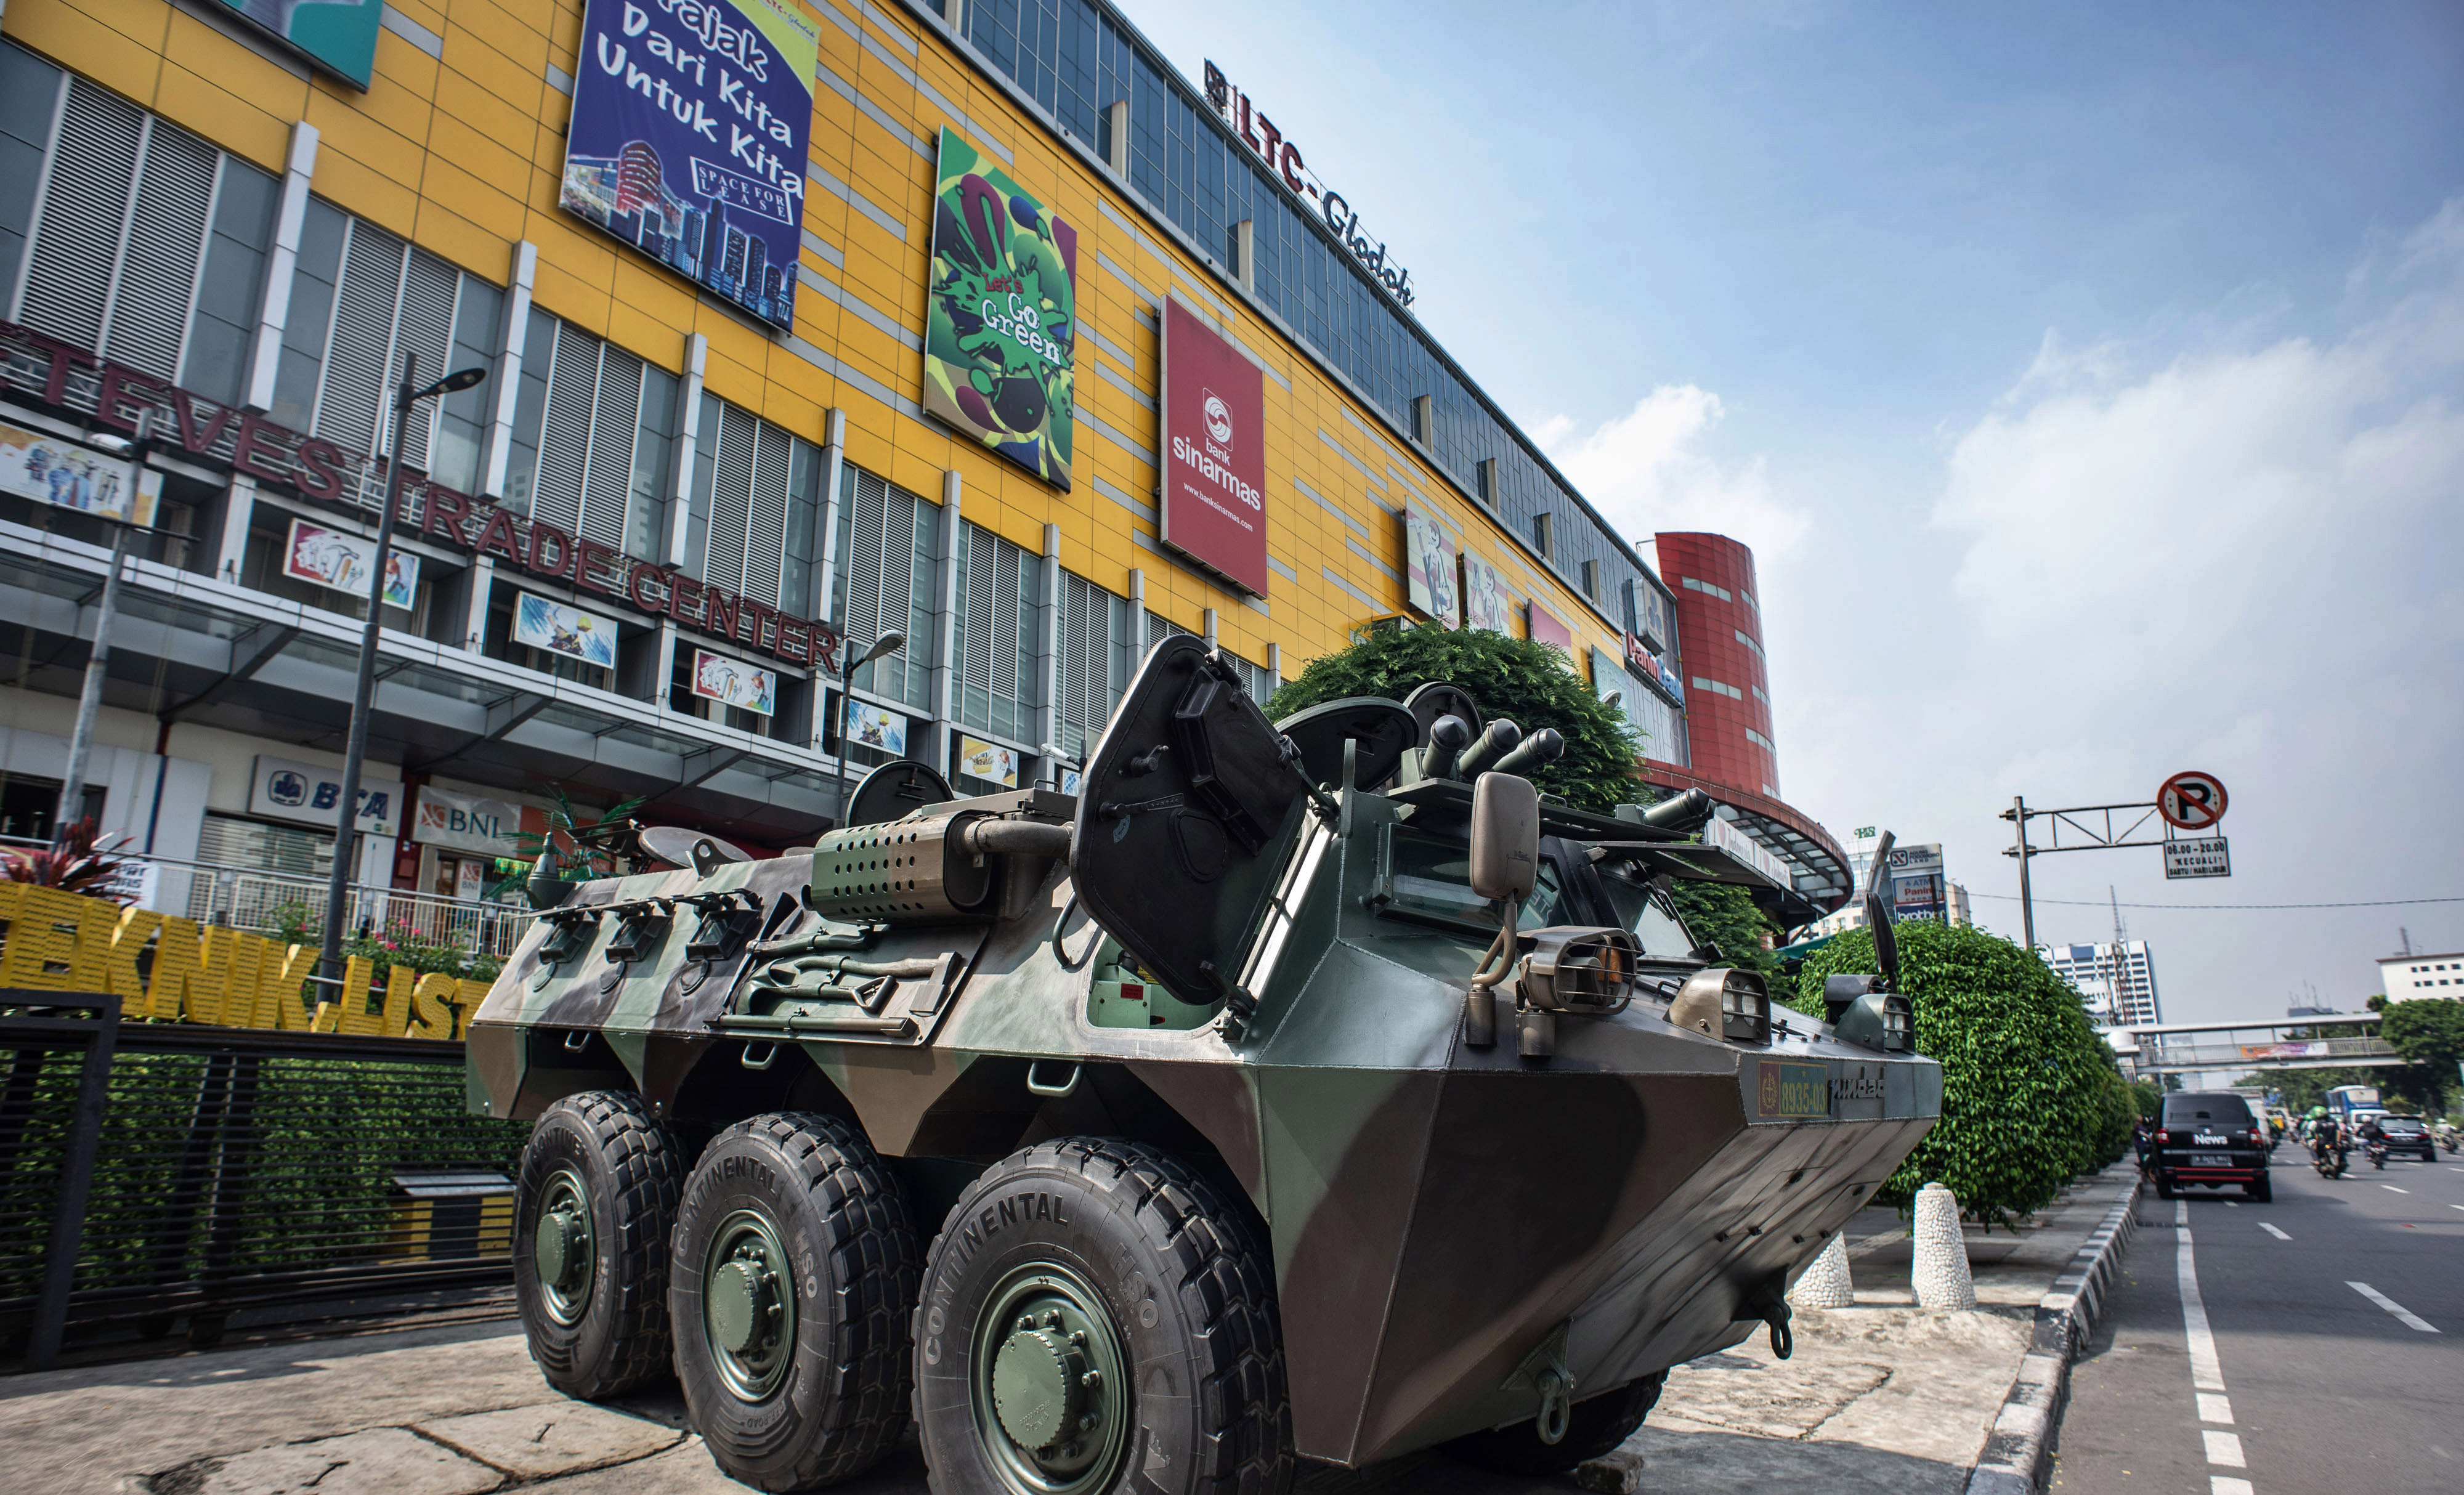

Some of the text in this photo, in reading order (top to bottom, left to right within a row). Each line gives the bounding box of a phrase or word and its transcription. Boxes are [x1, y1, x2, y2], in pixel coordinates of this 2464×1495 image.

[623, 1, 706, 86] Dari
[719, 68, 792, 148] Kita
[598, 32, 804, 200] Untuk Kita
[699, 166, 788, 206] SPACE FOR
[981, 272, 1023, 294] Let's
[1008, 293, 1040, 330] Go
[982, 299, 1062, 365] Green
[1206, 437, 1231, 466] bank
[1173, 436, 1261, 511] sinarmas
[0, 336, 840, 674] TEVES TRADE CENTER
[1183, 482, 1253, 532] www.banksinarmas.com
[311, 782, 389, 820] BA
[449, 809, 498, 838] BNI
[2167, 845, 2191, 855] 06.00
[2200, 842, 2225, 853] 20.00
[461, 880, 478, 889] BNI
[1781, 1082, 1826, 1114] 8935-03
[2193, 1133, 2227, 1145] News
[678, 1156, 777, 1257] CONTINENTAL
[925, 1192, 1068, 1365] CONTINENTAL
